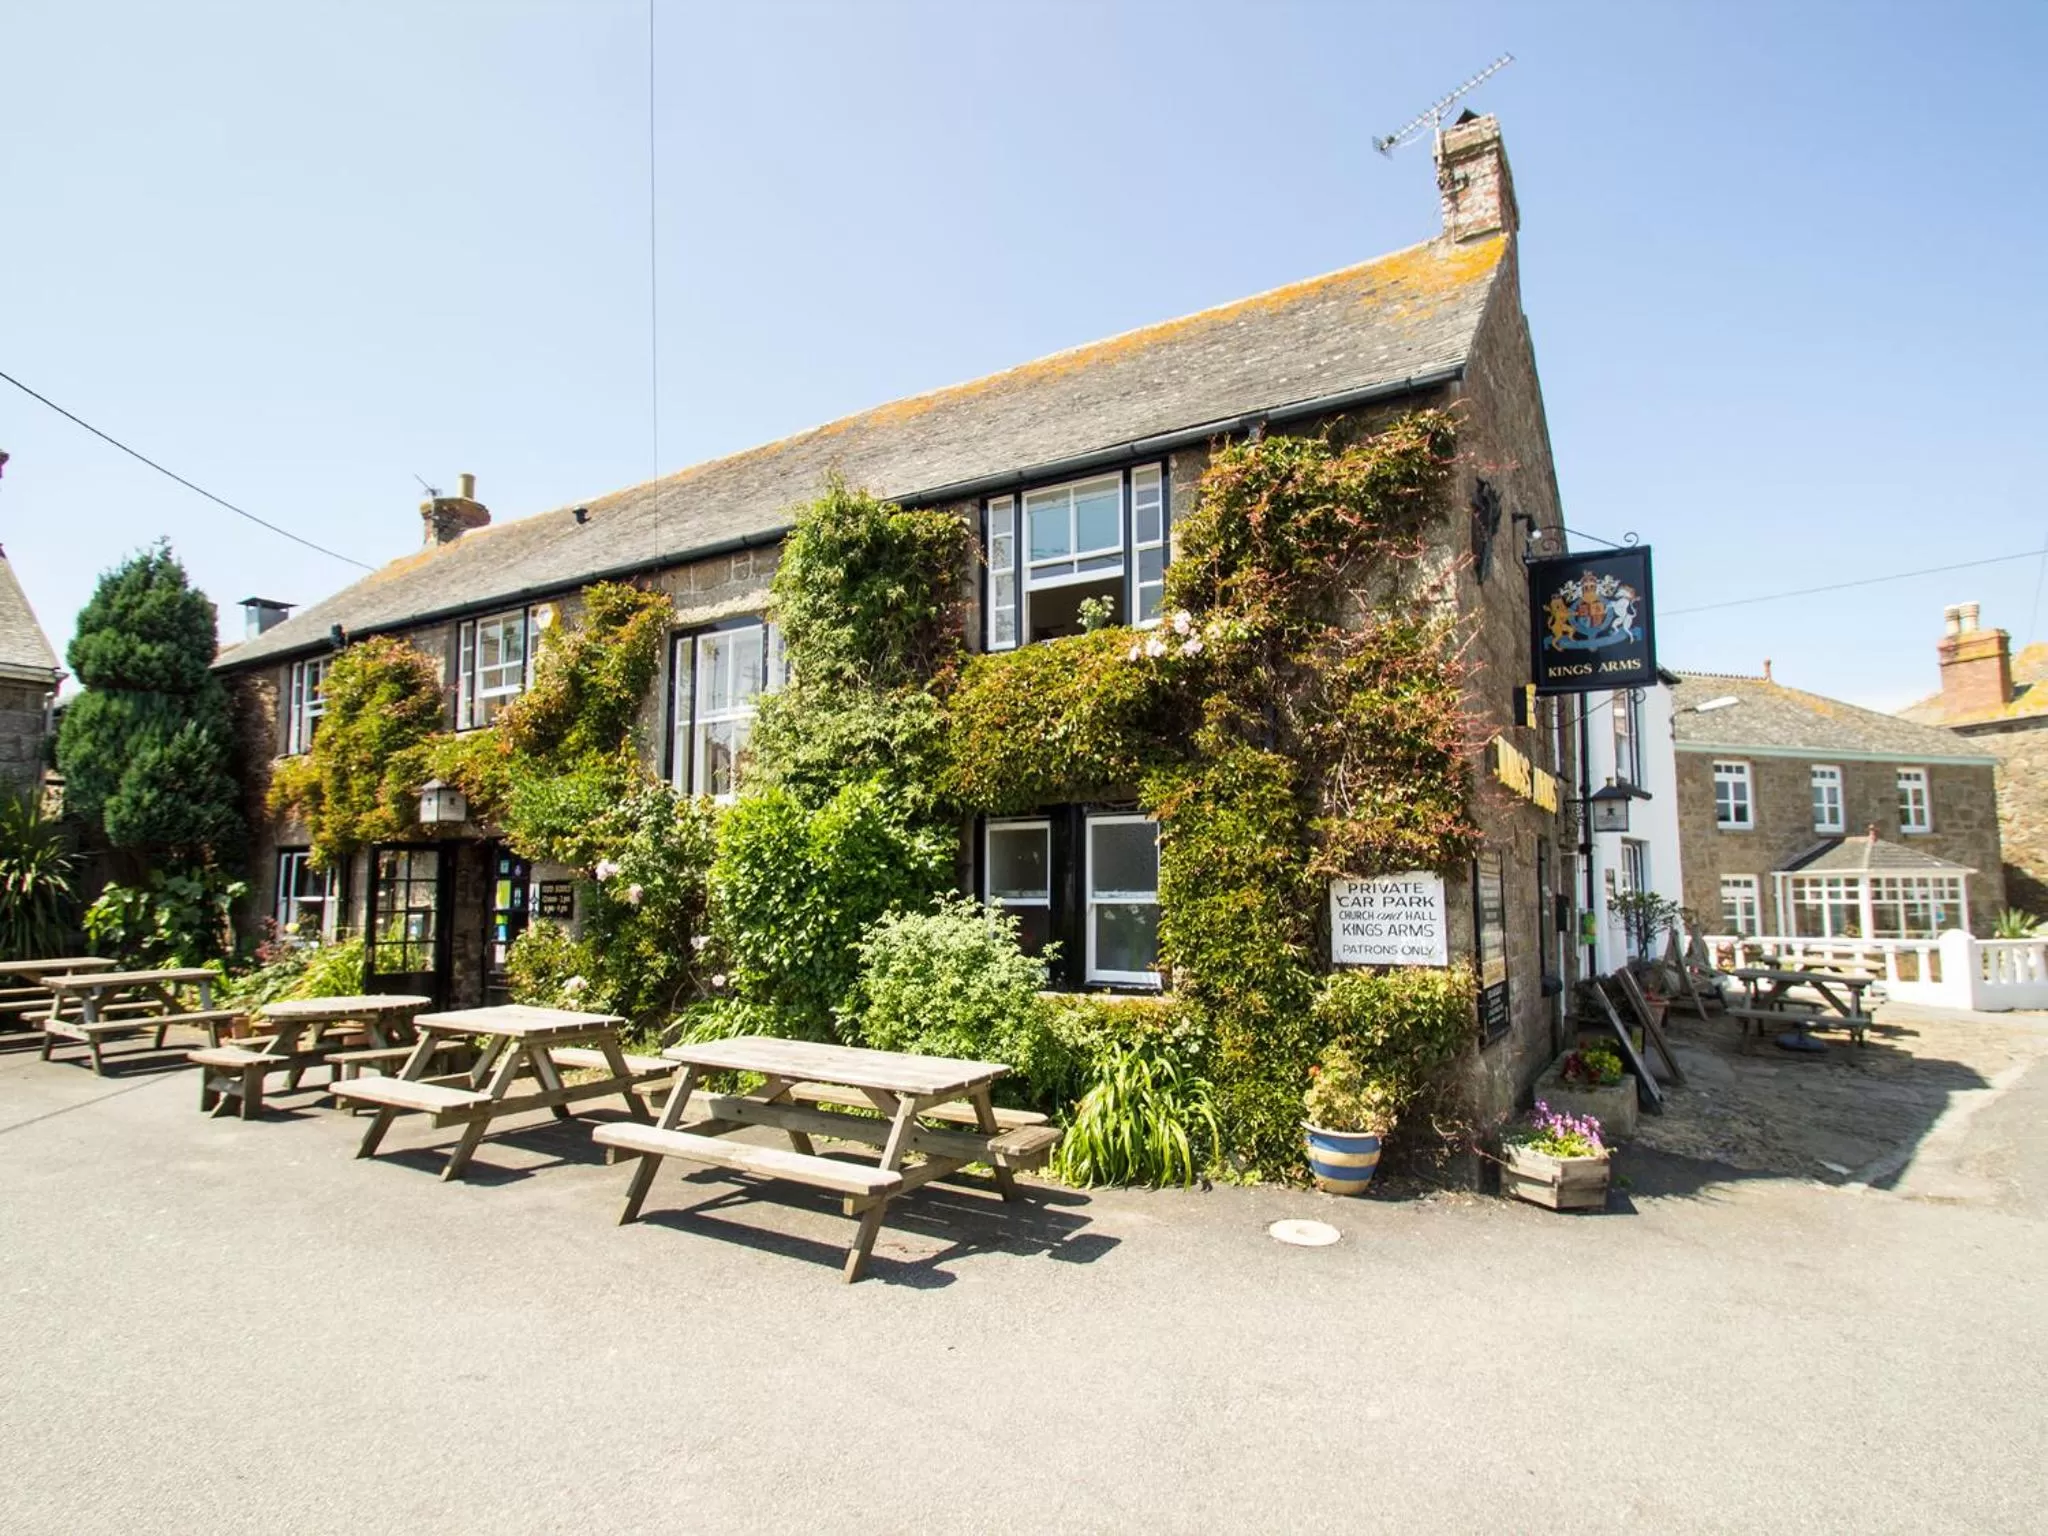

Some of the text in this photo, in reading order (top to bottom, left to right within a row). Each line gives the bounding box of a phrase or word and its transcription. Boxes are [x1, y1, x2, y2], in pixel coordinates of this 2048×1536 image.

[1548, 658, 1641, 677] KINGS ARMS
[1348, 882, 1424, 894] PRIVATE
[1338, 896, 1435, 908] CAR PARK
[1339, 910, 1437, 921] CHURCH and HALL
[1342, 923, 1435, 937] KINGS ARMS
[1343, 944, 1436, 956] PATRONS ONLY
